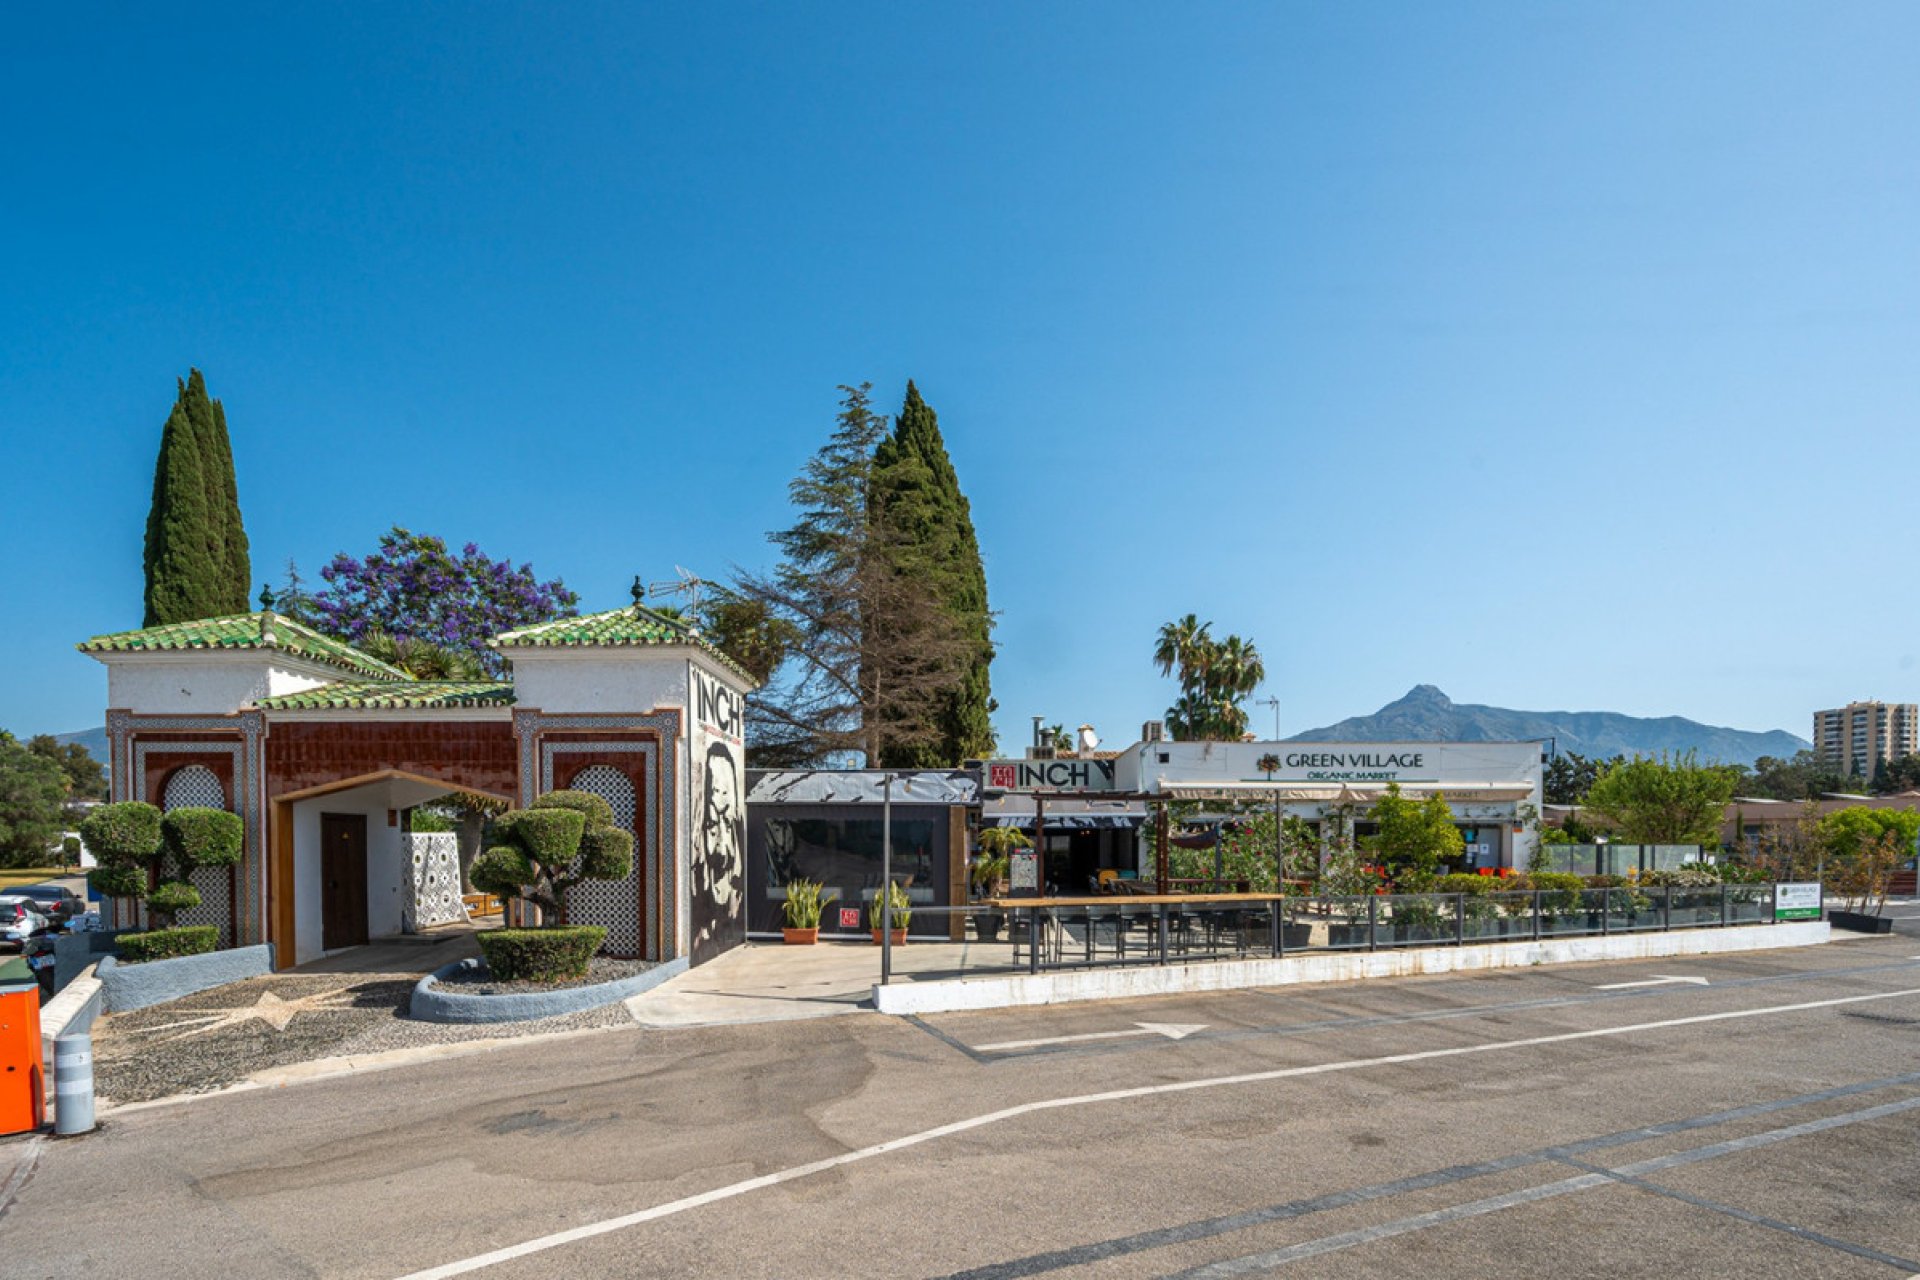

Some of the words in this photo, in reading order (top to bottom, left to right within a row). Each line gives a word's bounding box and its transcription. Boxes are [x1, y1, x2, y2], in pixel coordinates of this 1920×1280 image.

[696, 671, 739, 738] INCH
[1286, 753, 1344, 768] GREEN
[1349, 753, 1424, 768] VILLAGE
[1019, 763, 1090, 787] INCH
[1307, 771, 1354, 780] ORGANIC
[1356, 771, 1398, 780] MARKET
